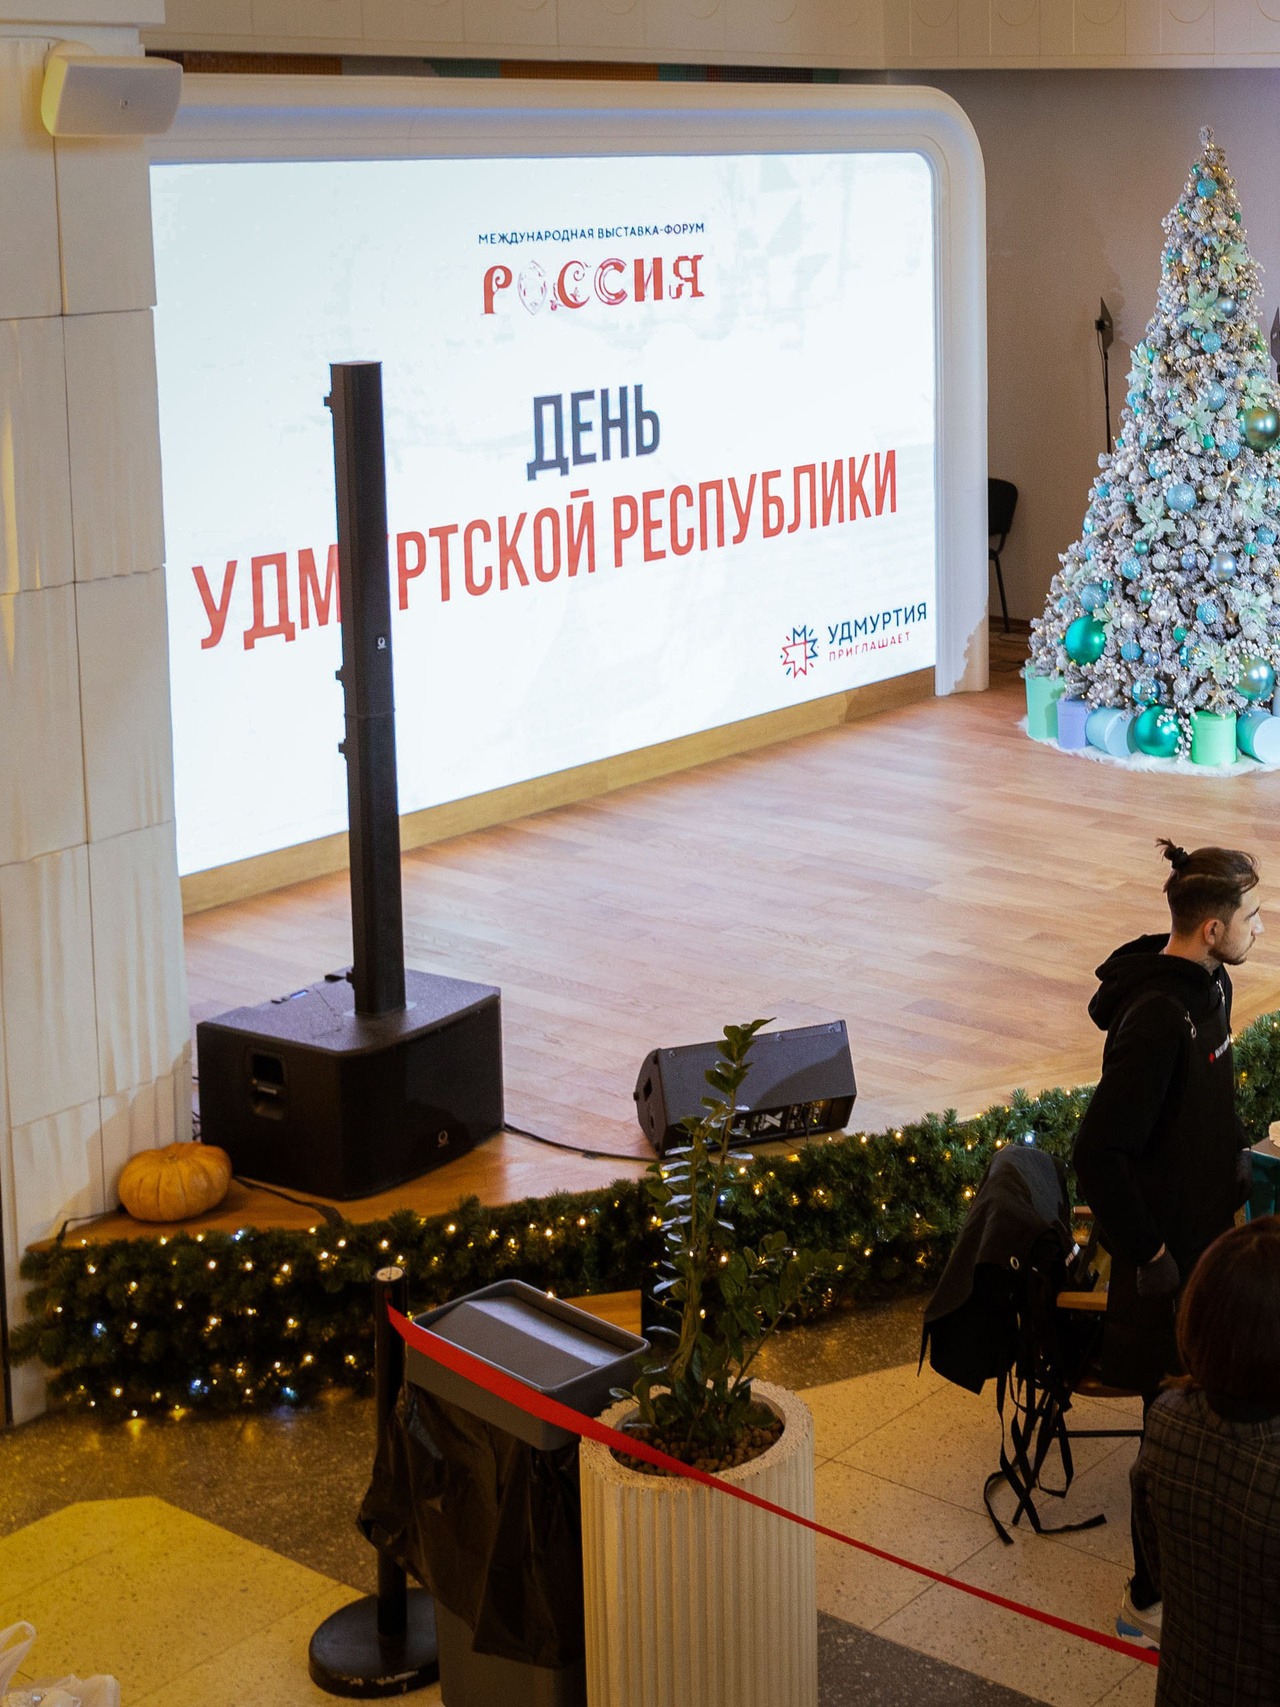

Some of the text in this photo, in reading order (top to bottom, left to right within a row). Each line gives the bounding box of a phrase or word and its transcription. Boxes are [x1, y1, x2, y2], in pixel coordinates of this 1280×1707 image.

[478, 222, 705, 245] МЕЖДУНАРОДНАЯ ВЫСТАВКА-ФОРУМ
[481, 254, 705, 315] РОССИЯ
[526, 384, 660, 481] ДЕНЬ
[192, 449, 897, 651] УДМРТСКОЙ РЕСПУБЛИКИ
[827, 602, 927, 645] УДМУРТИЯ
[829, 631, 910, 661] ПРИГЛАШАЕТ
